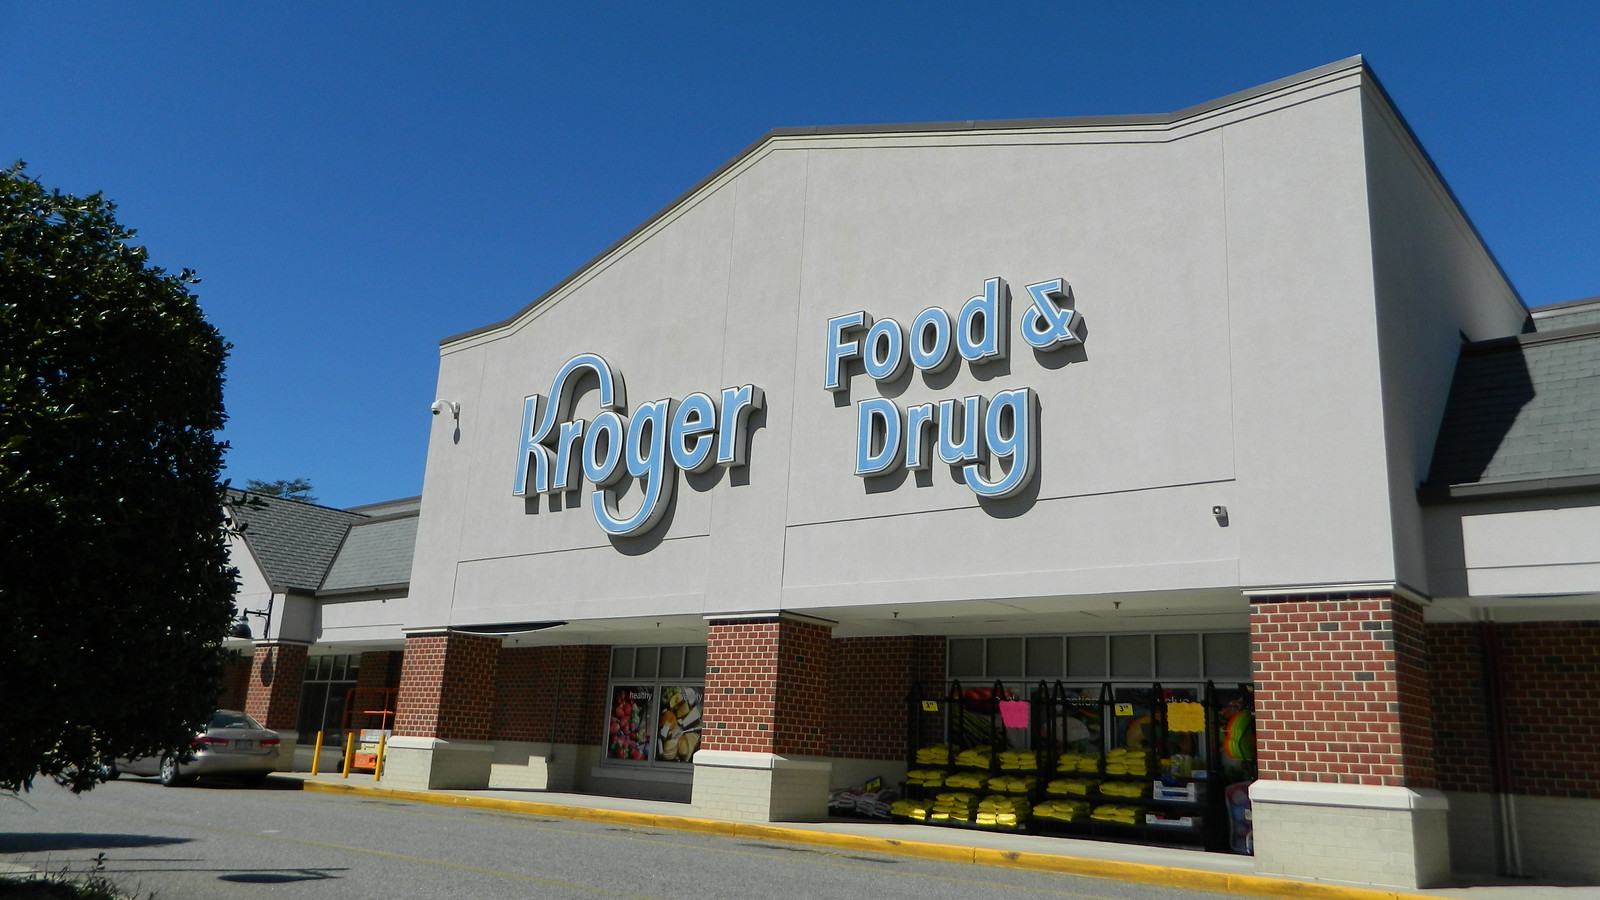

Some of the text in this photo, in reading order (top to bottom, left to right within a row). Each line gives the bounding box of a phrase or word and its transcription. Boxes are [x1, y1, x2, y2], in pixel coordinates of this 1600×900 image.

[823, 276, 1081, 392] Food &
[513, 352, 761, 537] Kroger
[854, 386, 1035, 499] Drug
[629, 690, 652, 702] healthy
